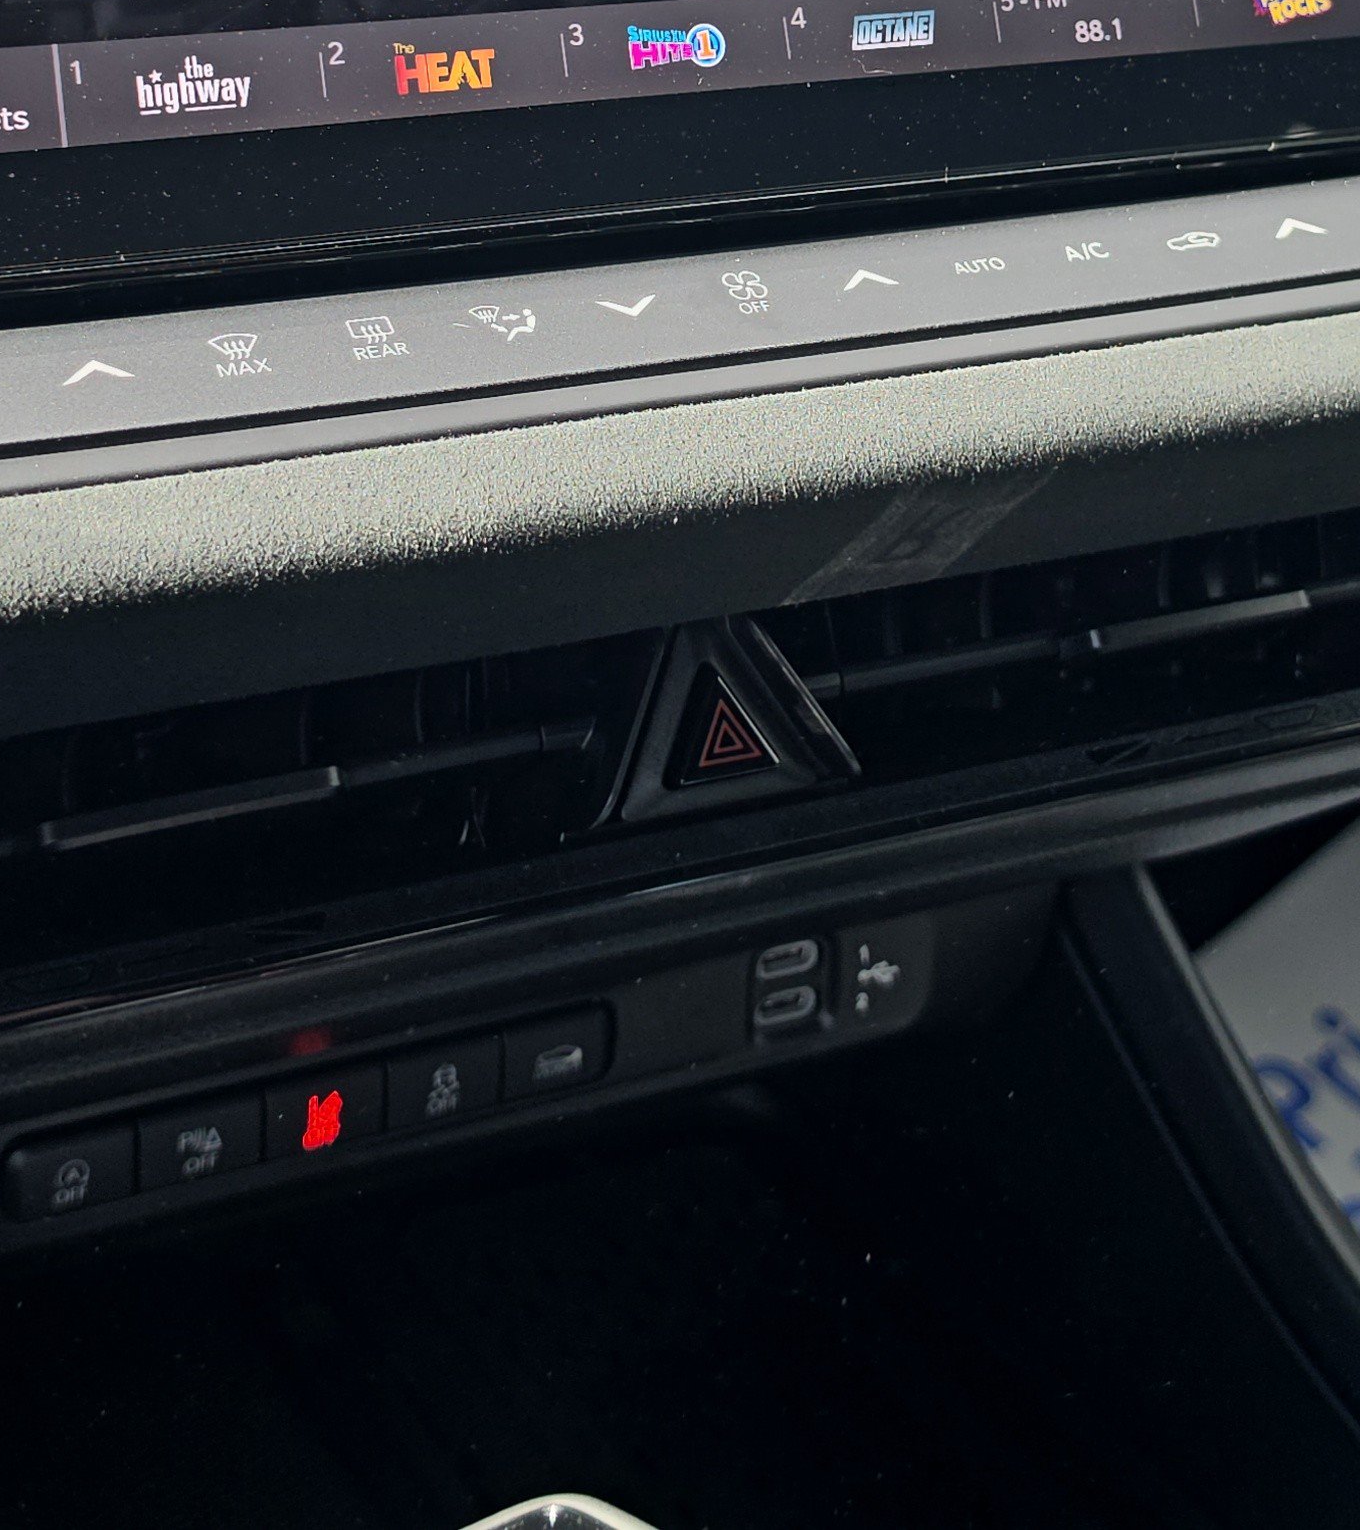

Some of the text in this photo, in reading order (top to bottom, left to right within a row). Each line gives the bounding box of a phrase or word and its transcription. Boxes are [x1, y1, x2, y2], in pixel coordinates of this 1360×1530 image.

[791, 7, 806, 28] 4
[569, 24, 583, 45] 3
[856, 15, 931, 45] OCTANE
[1075, 18, 1121, 42] 88.1
[328, 42, 345, 65] 2
[393, 42, 416, 54] The
[628, 41, 694, 70] HITS
[71, 61, 81, 84] 1
[184, 55, 214, 79] the
[394, 48, 495, 95] HEAT
[136, 70, 251, 114] highway
[1065, 242, 1109, 261] A/C
[955, 257, 1005, 274] AUTO
[738, 299, 771, 315] OFF
[352, 342, 410, 361] REAR
[215, 358, 273, 378] MAX
